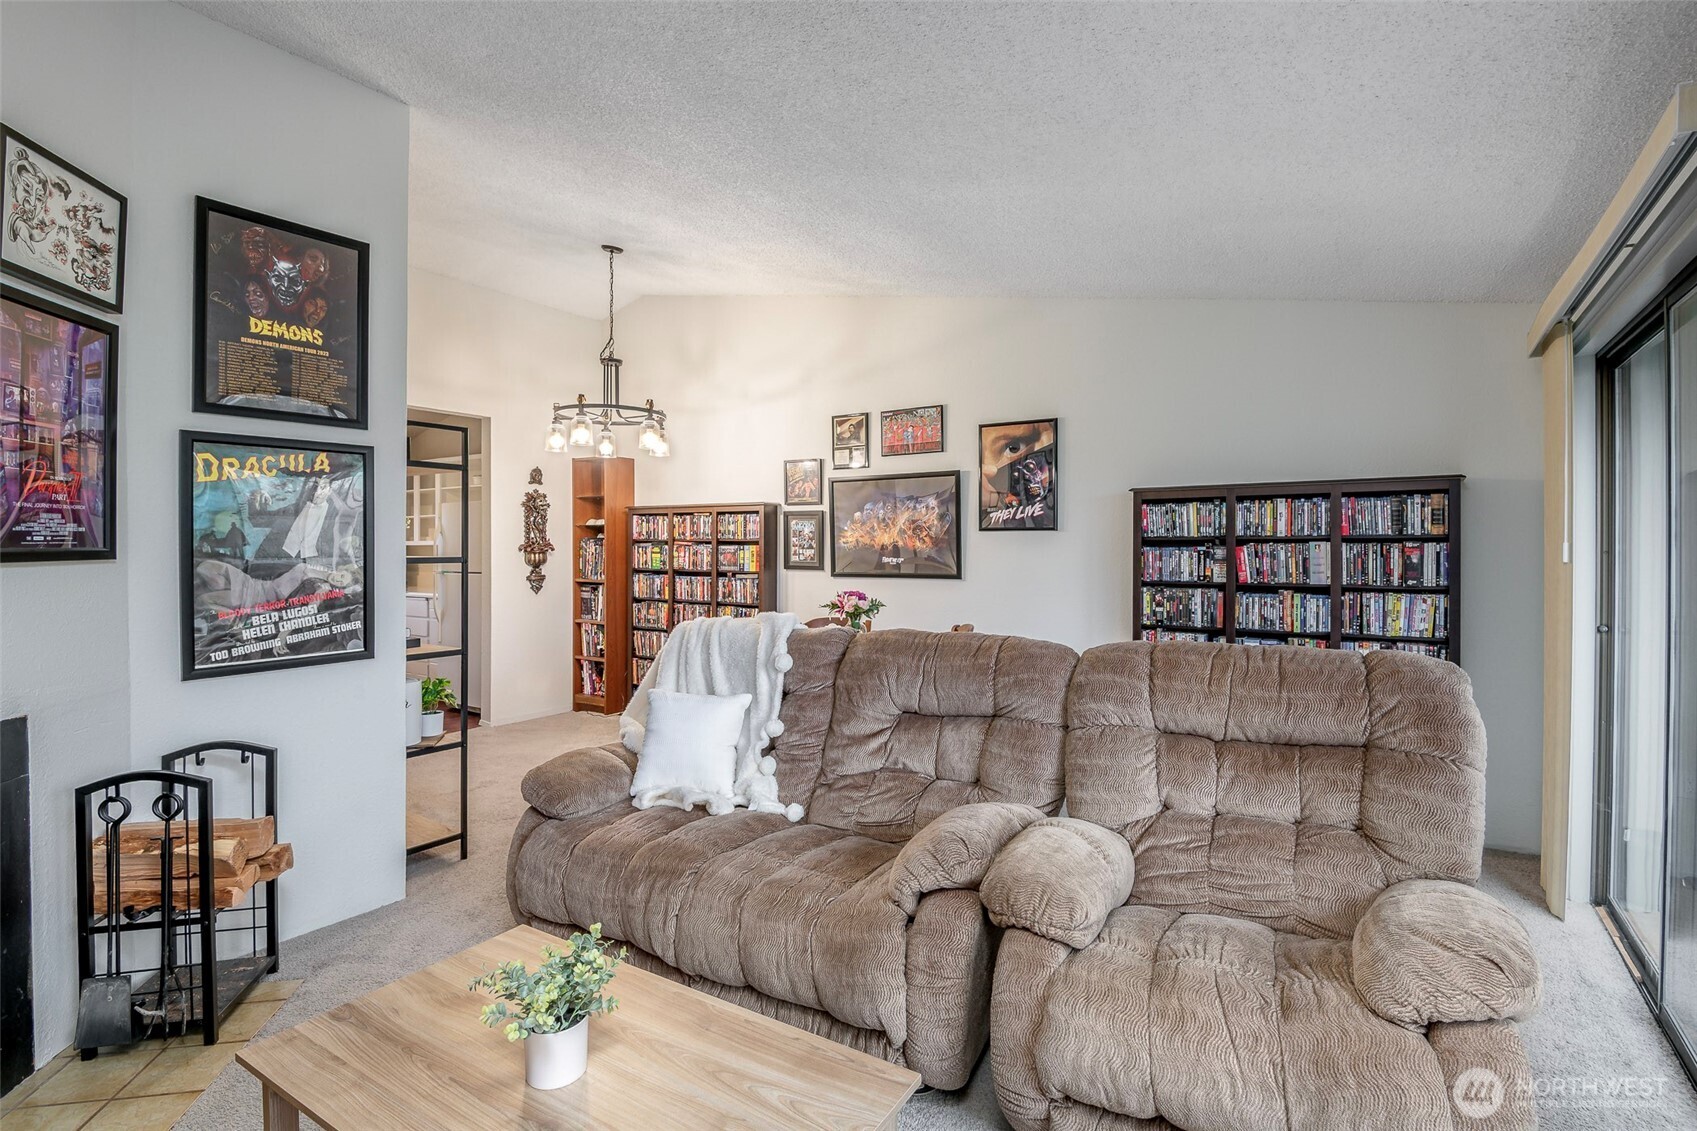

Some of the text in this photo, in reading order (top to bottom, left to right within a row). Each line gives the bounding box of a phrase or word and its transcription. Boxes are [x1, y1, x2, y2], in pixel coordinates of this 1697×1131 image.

[248, 316, 324, 346] DEMONS
[241, 336, 262, 345] DEMONS
[263, 340, 280, 348] NORTH
[280, 343, 304, 352] AMERICAN
[196, 452, 331, 482] DRACULA
[51, 493, 68, 501] PART
[990, 501, 1045, 525] THEY LIVE
[251, 611, 280, 626] BELA
[281, 603, 318, 620] LUGOSI
[255, 599, 287, 613] TERROR
[242, 623, 276, 640] HELEN
[278, 612, 330, 632] CHANDLER
[286, 626, 331, 645] ABRAHAM
[331, 620, 362, 634] STOKER
[209, 649, 229, 662] TOD
[231, 637, 281, 657] BROWNING
